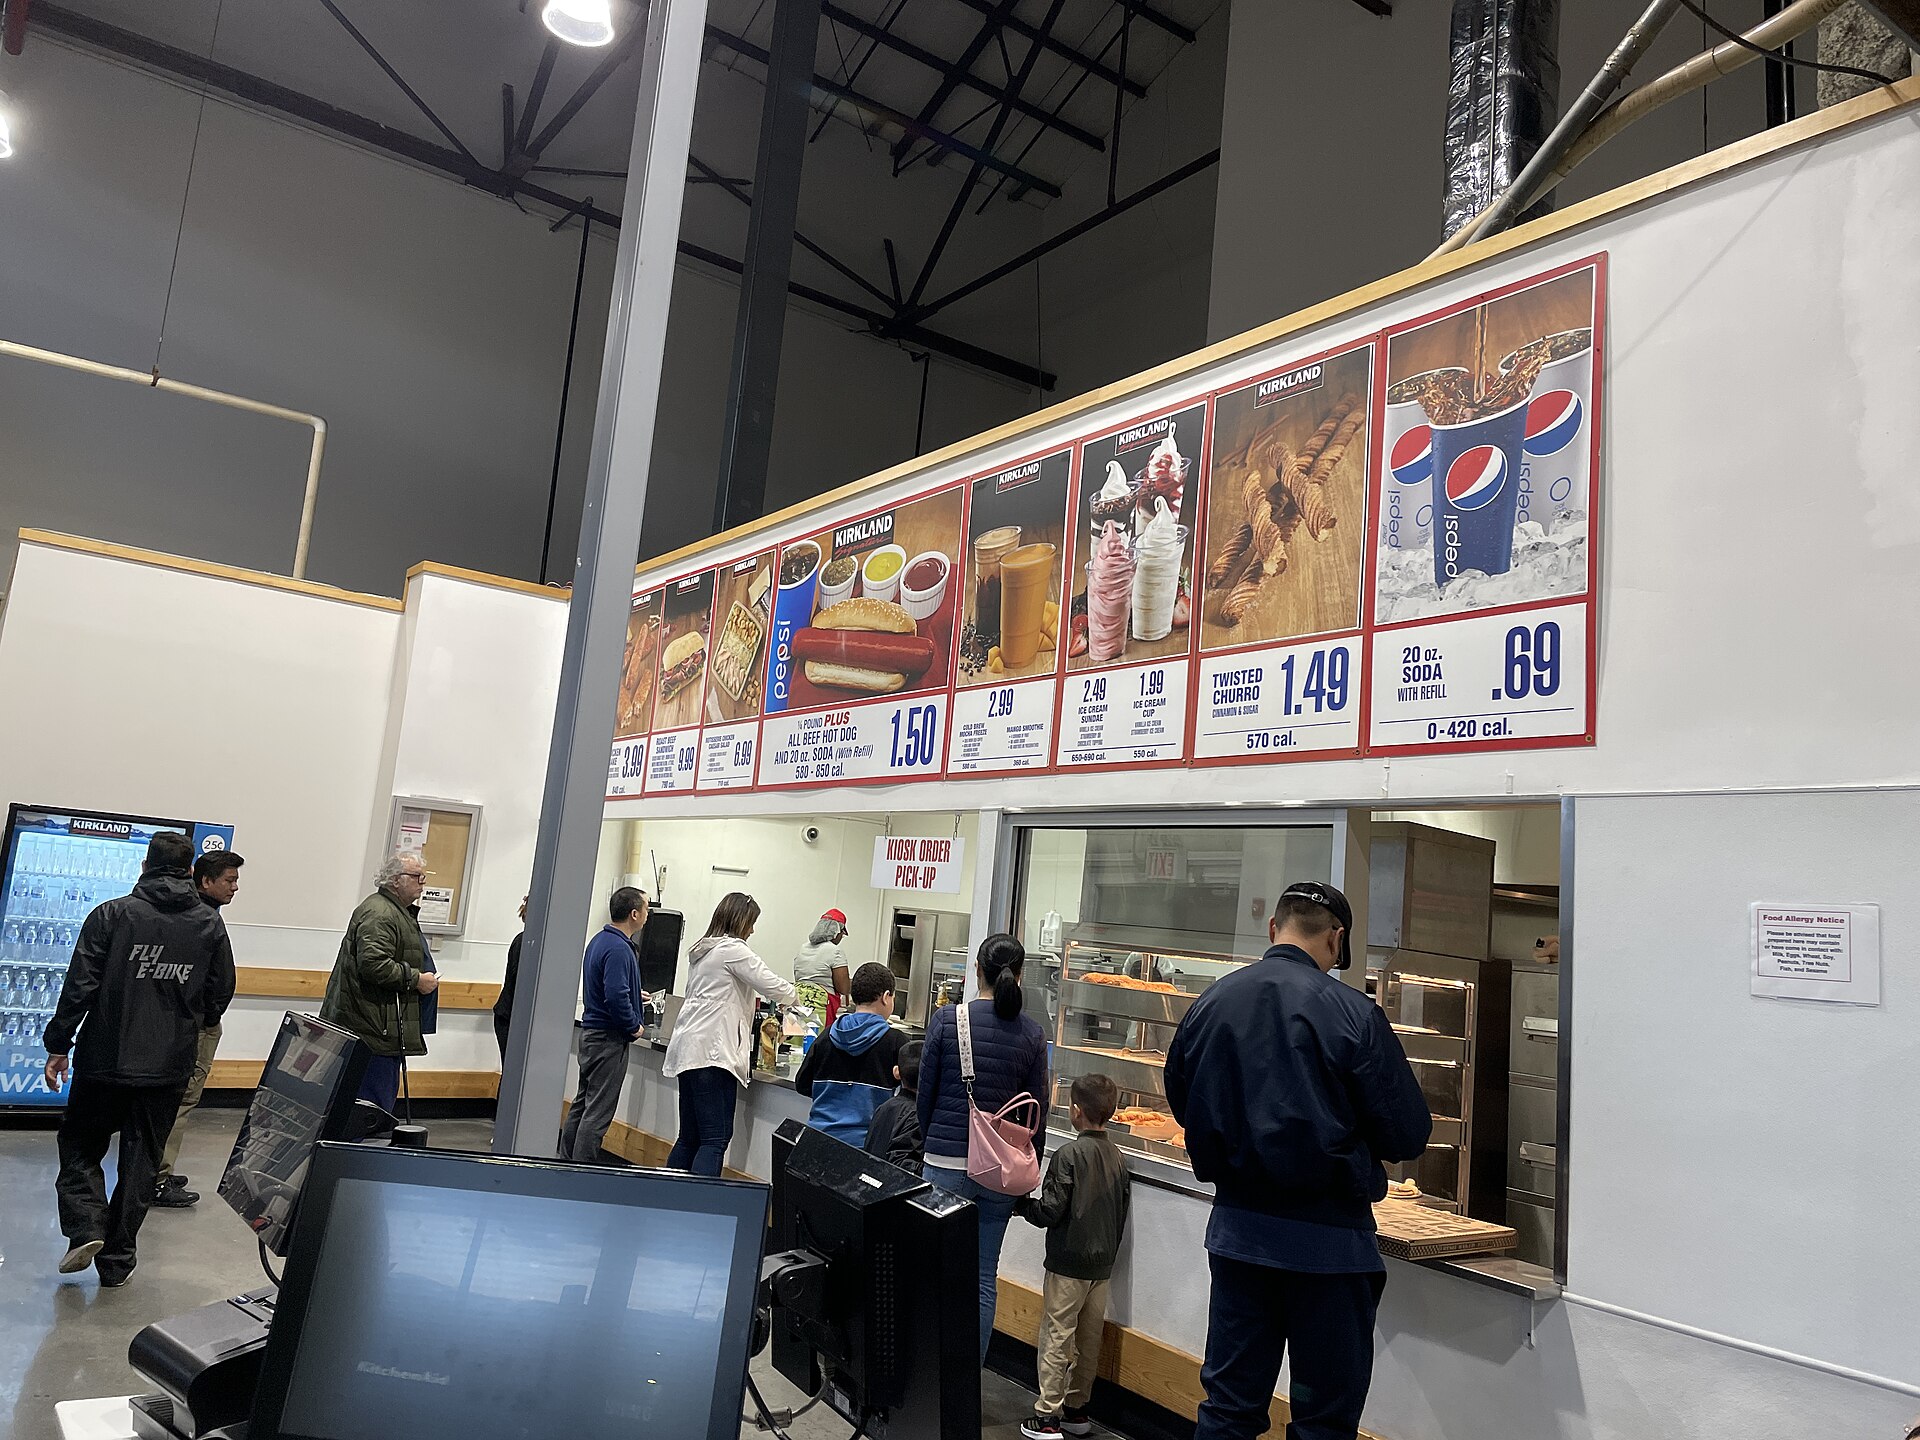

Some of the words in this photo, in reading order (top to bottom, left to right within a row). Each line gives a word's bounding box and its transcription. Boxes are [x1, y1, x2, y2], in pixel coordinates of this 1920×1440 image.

[1258, 365, 1321, 397] KIRKLAND
[1118, 419, 1169, 446] KIRKLAND
[998, 462, 1040, 485] KIRKLAND
[1388, 490, 1402, 548] pepsi
[835, 514, 893, 548] KIRKLAND
[1444, 514, 1462, 578] pepsi
[774, 620, 791, 699] pepsi
[1402, 647, 1420, 664] 20
[1424, 648, 1443, 662] oz.
[1491, 622, 1561, 701] .69
[1140, 669, 1164, 696] 1.99
[1212, 668, 1263, 685] TWISTED
[1280, 646, 1350, 716] 1.49
[1402, 663, 1443, 683] SODA
[1083, 678, 1106, 702] 2.49
[1212, 686, 1260, 705] CHURRO
[1398, 687, 1417, 702] WITH
[1420, 684, 1447, 700] REFILL
[988, 688, 1014, 718] 2.99
[1088, 704, 1108, 713] CREAM
[1133, 700, 1143, 709] ICE
[1144, 698, 1166, 708] CREAM
[1243, 704, 1259, 715] SUGAR
[803, 718, 823, 729] POUND
[824, 711, 850, 727] PLUS
[1081, 714, 1103, 724] SUNDAE
[1142, 709, 1155, 718] CUP
[788, 733, 801, 747] ALL
[802, 731, 821, 745] BEEF
[823, 728, 838, 744] HOT
[840, 726, 857, 742] DOG
[890, 704, 936, 767] 1.50
[1482, 717, 1513, 736] cal.
[656, 745, 674, 754] SANDWICH
[667, 736, 677, 744] BEEF
[1246, 732, 1270, 749] 570
[1272, 730, 1297, 747] cal.
[622, 744, 644, 778] 3.99
[677, 746, 695, 772] 9.99
[734, 740, 752, 767] 6.99
[774, 751, 788, 765] AND
[790, 750, 799, 763] 20
[801, 752, 810, 762] oz.
[812, 746, 833, 761] SODA
[835, 747, 852, 762] (With
[853, 744, 874, 758] Refill)
[1071, 753, 1094, 762] 650-690
[1096, 752, 1106, 760] cal.
[1134, 750, 1145, 758] 550
[1146, 749, 1158, 758] cal.
[795, 766, 809, 779] 580
[815, 764, 830, 777] 850
[831, 762, 845, 776] cal.
[72, 819, 130, 834] KIRKLAND
[886, 839, 917, 862] KIOSK
[919, 840, 951, 863] ORDER
[895, 865, 936, 889] PICK-UP
[1785, 915, 1814, 923] Allergy
[1816, 916, 1845, 924] Notice
[129, 944, 164, 963] FLY
[136, 963, 194, 984] E-BIKE
